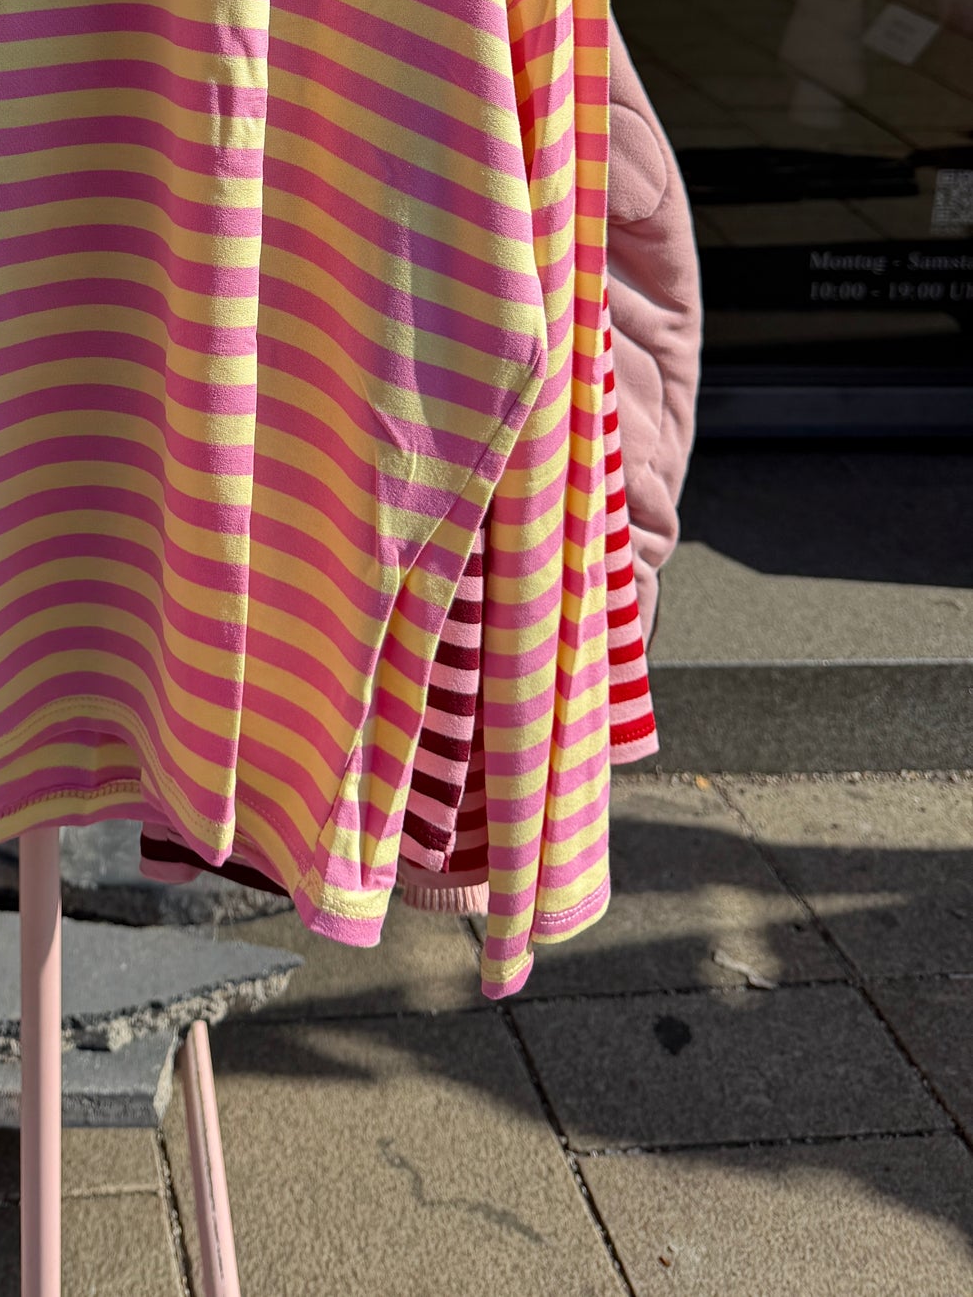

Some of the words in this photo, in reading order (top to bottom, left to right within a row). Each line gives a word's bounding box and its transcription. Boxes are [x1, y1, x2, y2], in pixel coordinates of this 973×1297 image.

[809, 250, 887, 275] Montag
[810, 281, 868, 302] 10:00
[889, 281, 945, 302] 19:00
